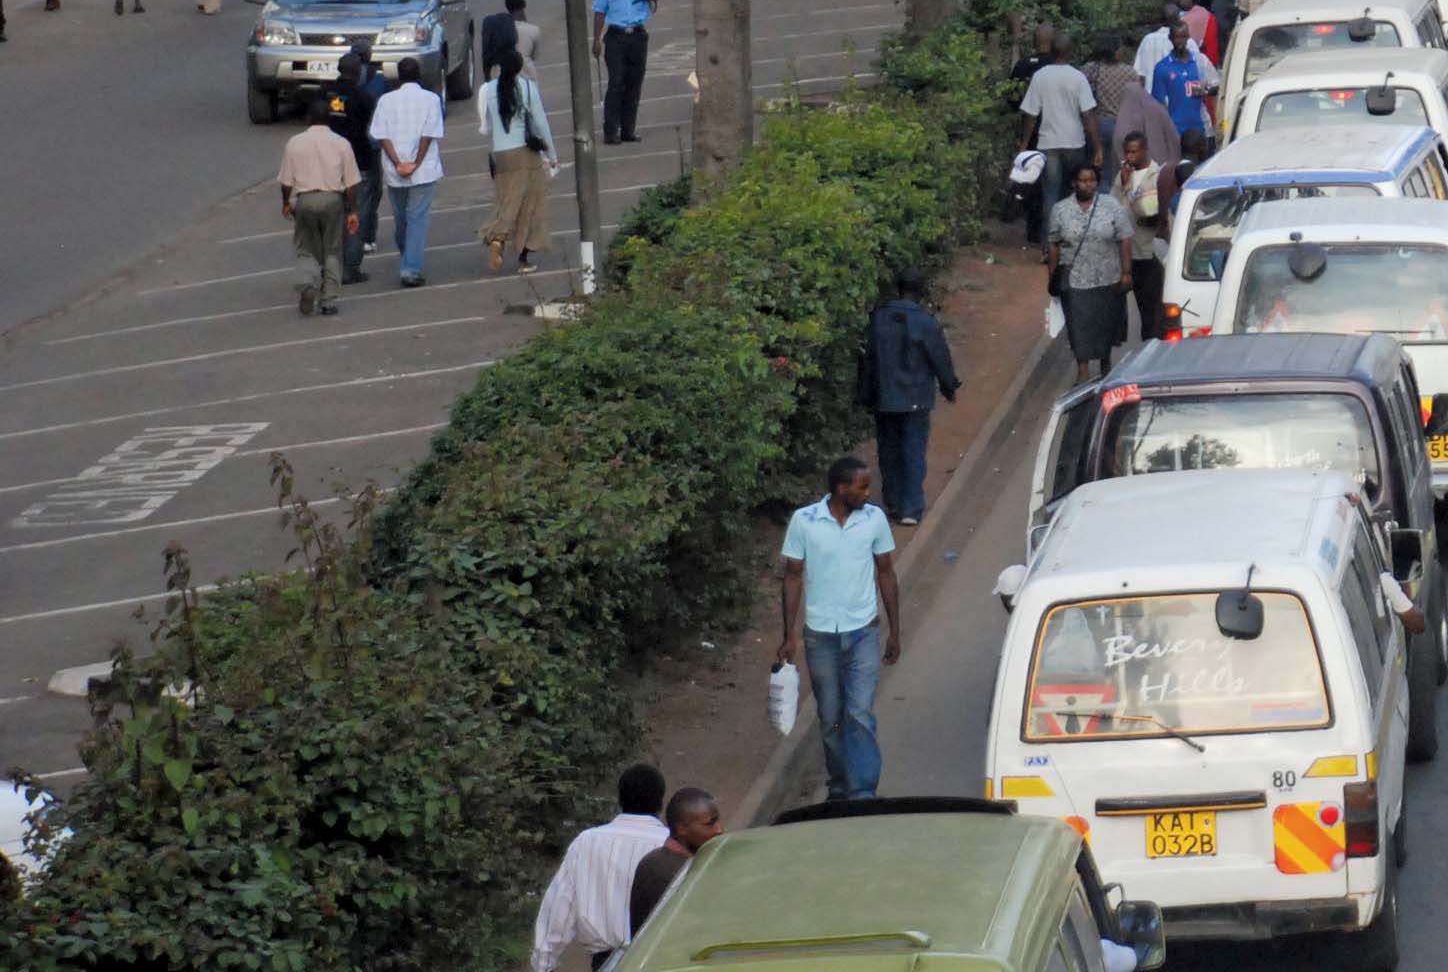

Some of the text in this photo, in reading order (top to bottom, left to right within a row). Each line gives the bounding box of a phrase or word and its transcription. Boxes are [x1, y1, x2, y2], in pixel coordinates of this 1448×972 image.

[1272, 770, 1297, 788] 80
[1153, 813, 1197, 832] KAT
[1152, 833, 1214, 856] 032B
